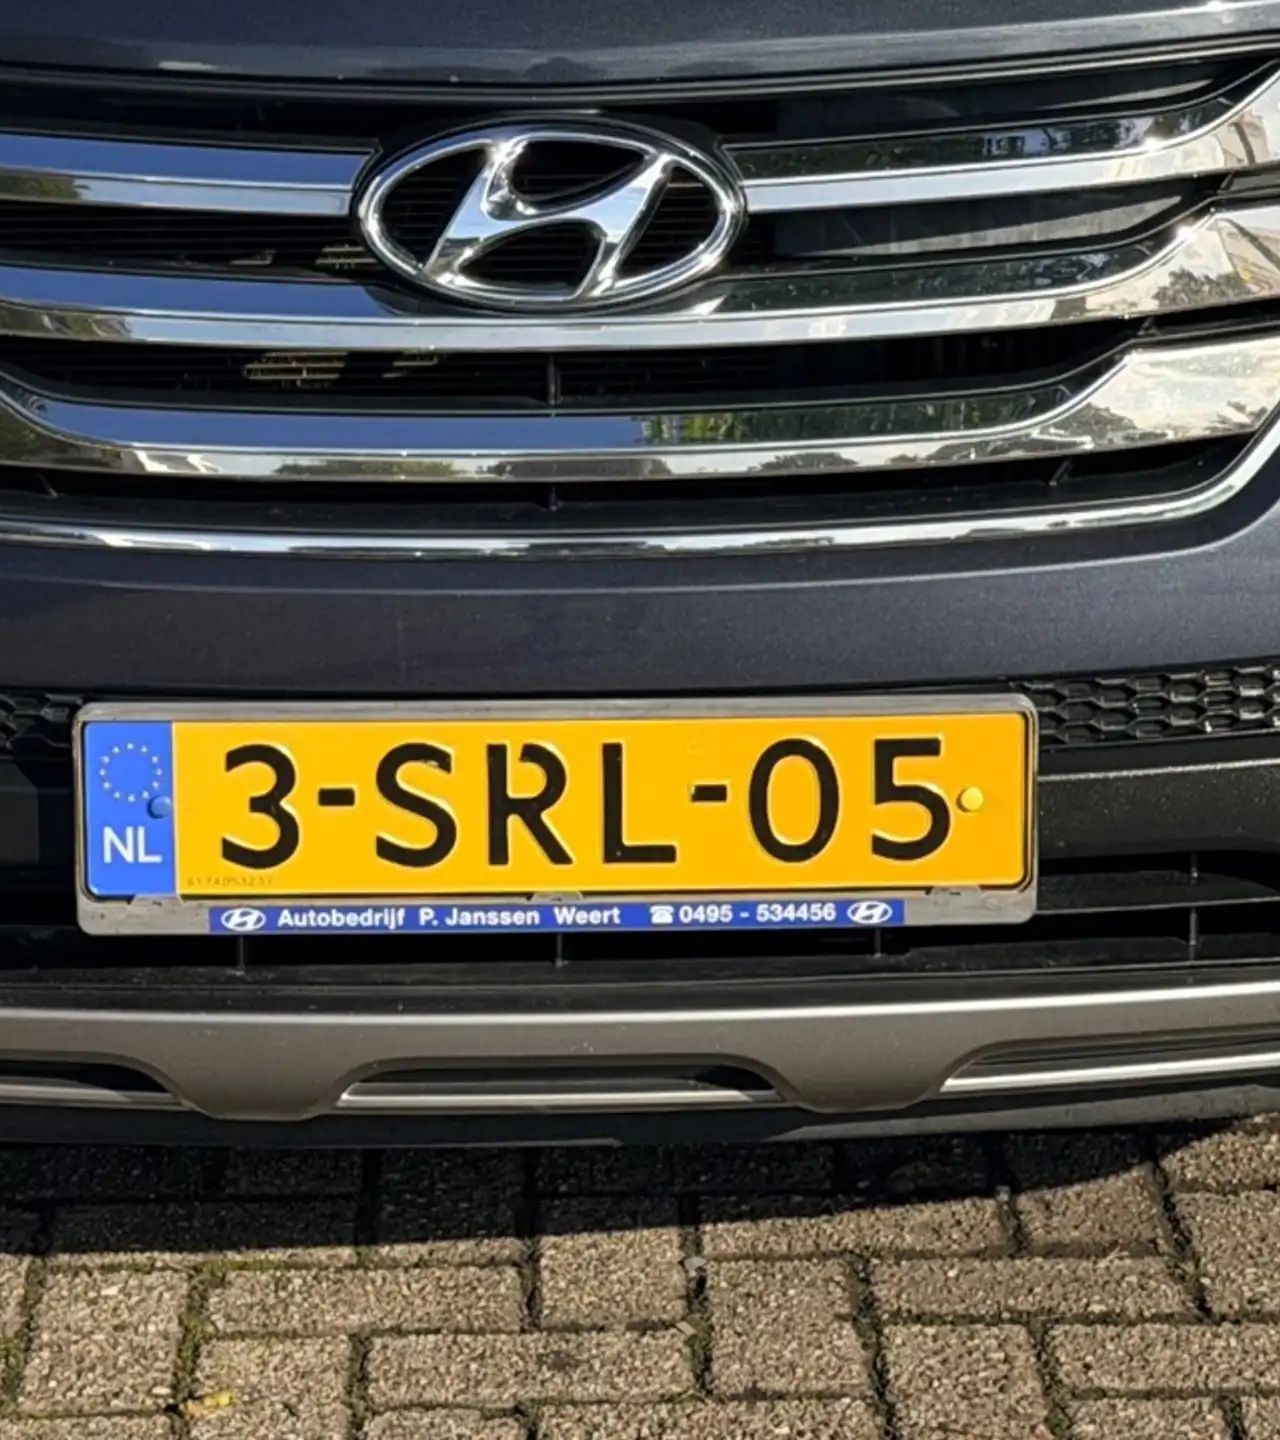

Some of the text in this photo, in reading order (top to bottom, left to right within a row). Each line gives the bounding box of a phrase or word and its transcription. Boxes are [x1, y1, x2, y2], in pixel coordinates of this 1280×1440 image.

[102, 736, 953, 870] NL 3-SRL-05
[277, 907, 406, 930] Autobedrijf
[419, 908, 439, 927] P.
[445, 907, 539, 927] Janssen
[554, 905, 621, 925] Weert
[679, 903, 733, 924] 0495
[756, 902, 836, 922] 534456
